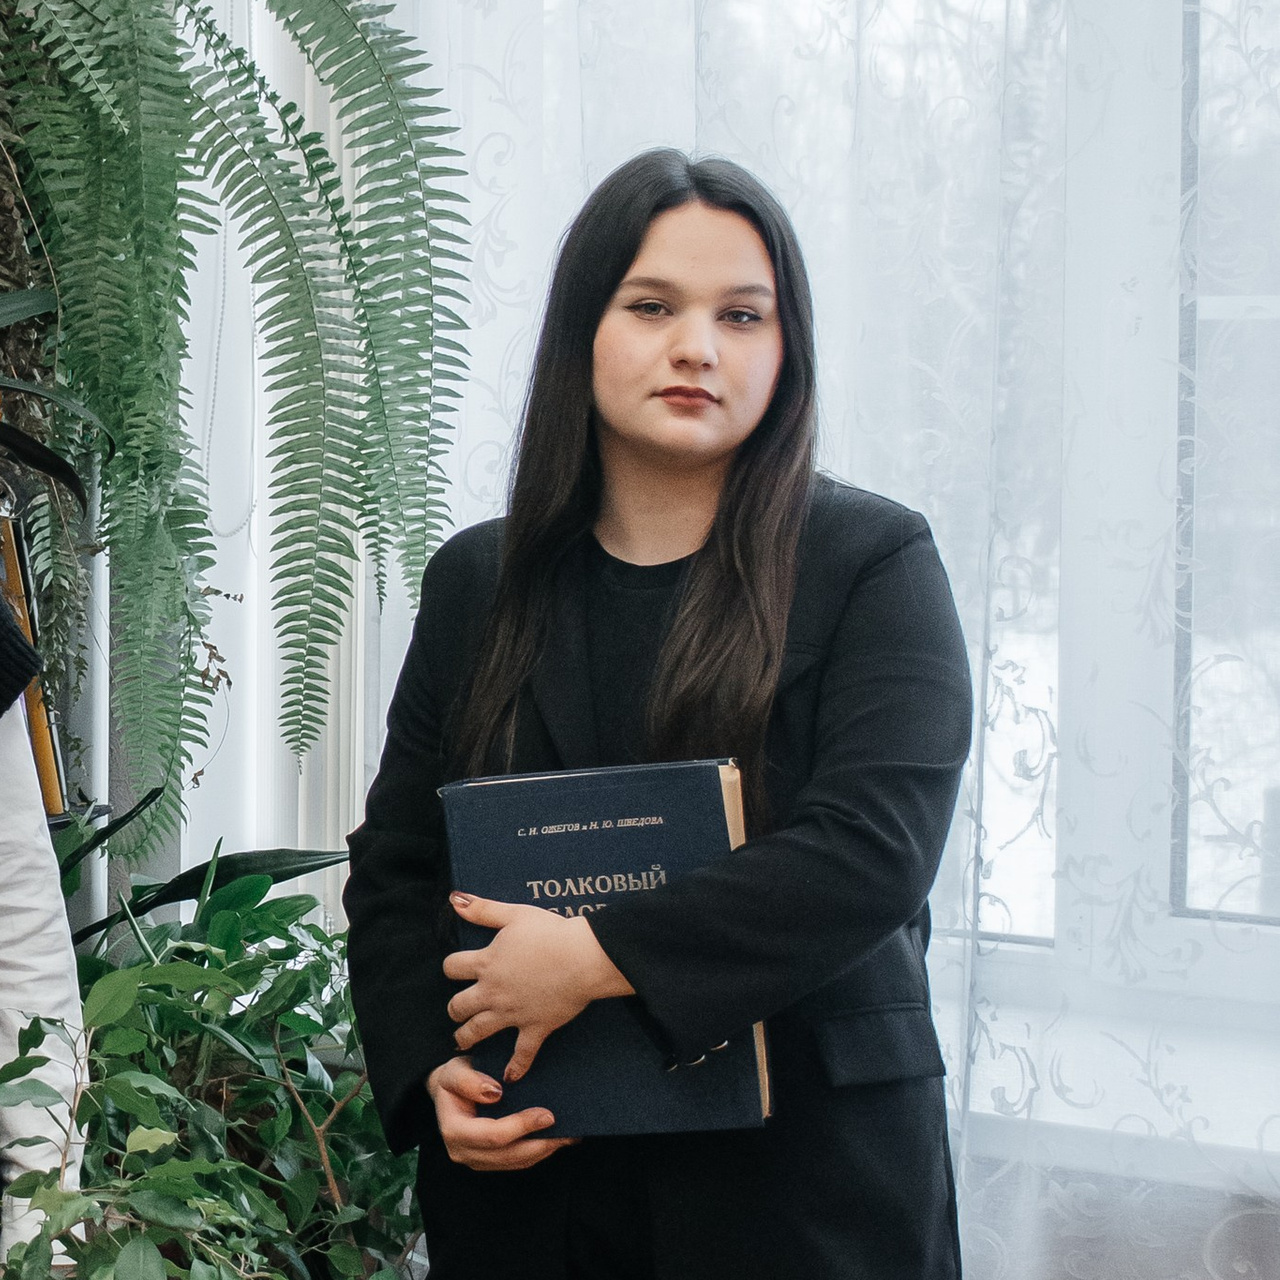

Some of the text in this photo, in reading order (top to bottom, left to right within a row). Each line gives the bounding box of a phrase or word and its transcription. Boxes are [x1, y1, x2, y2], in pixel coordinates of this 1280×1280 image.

[517, 828, 527, 837] С.
[541, 823, 580, 835] ОЖЕГОВ
[589, 821, 600, 830] Н.
[601, 819, 614, 829] Ю.
[617, 816, 664, 828] ШВЕДОВА
[526, 863, 667, 899] ТОЛКОВЫЙ
